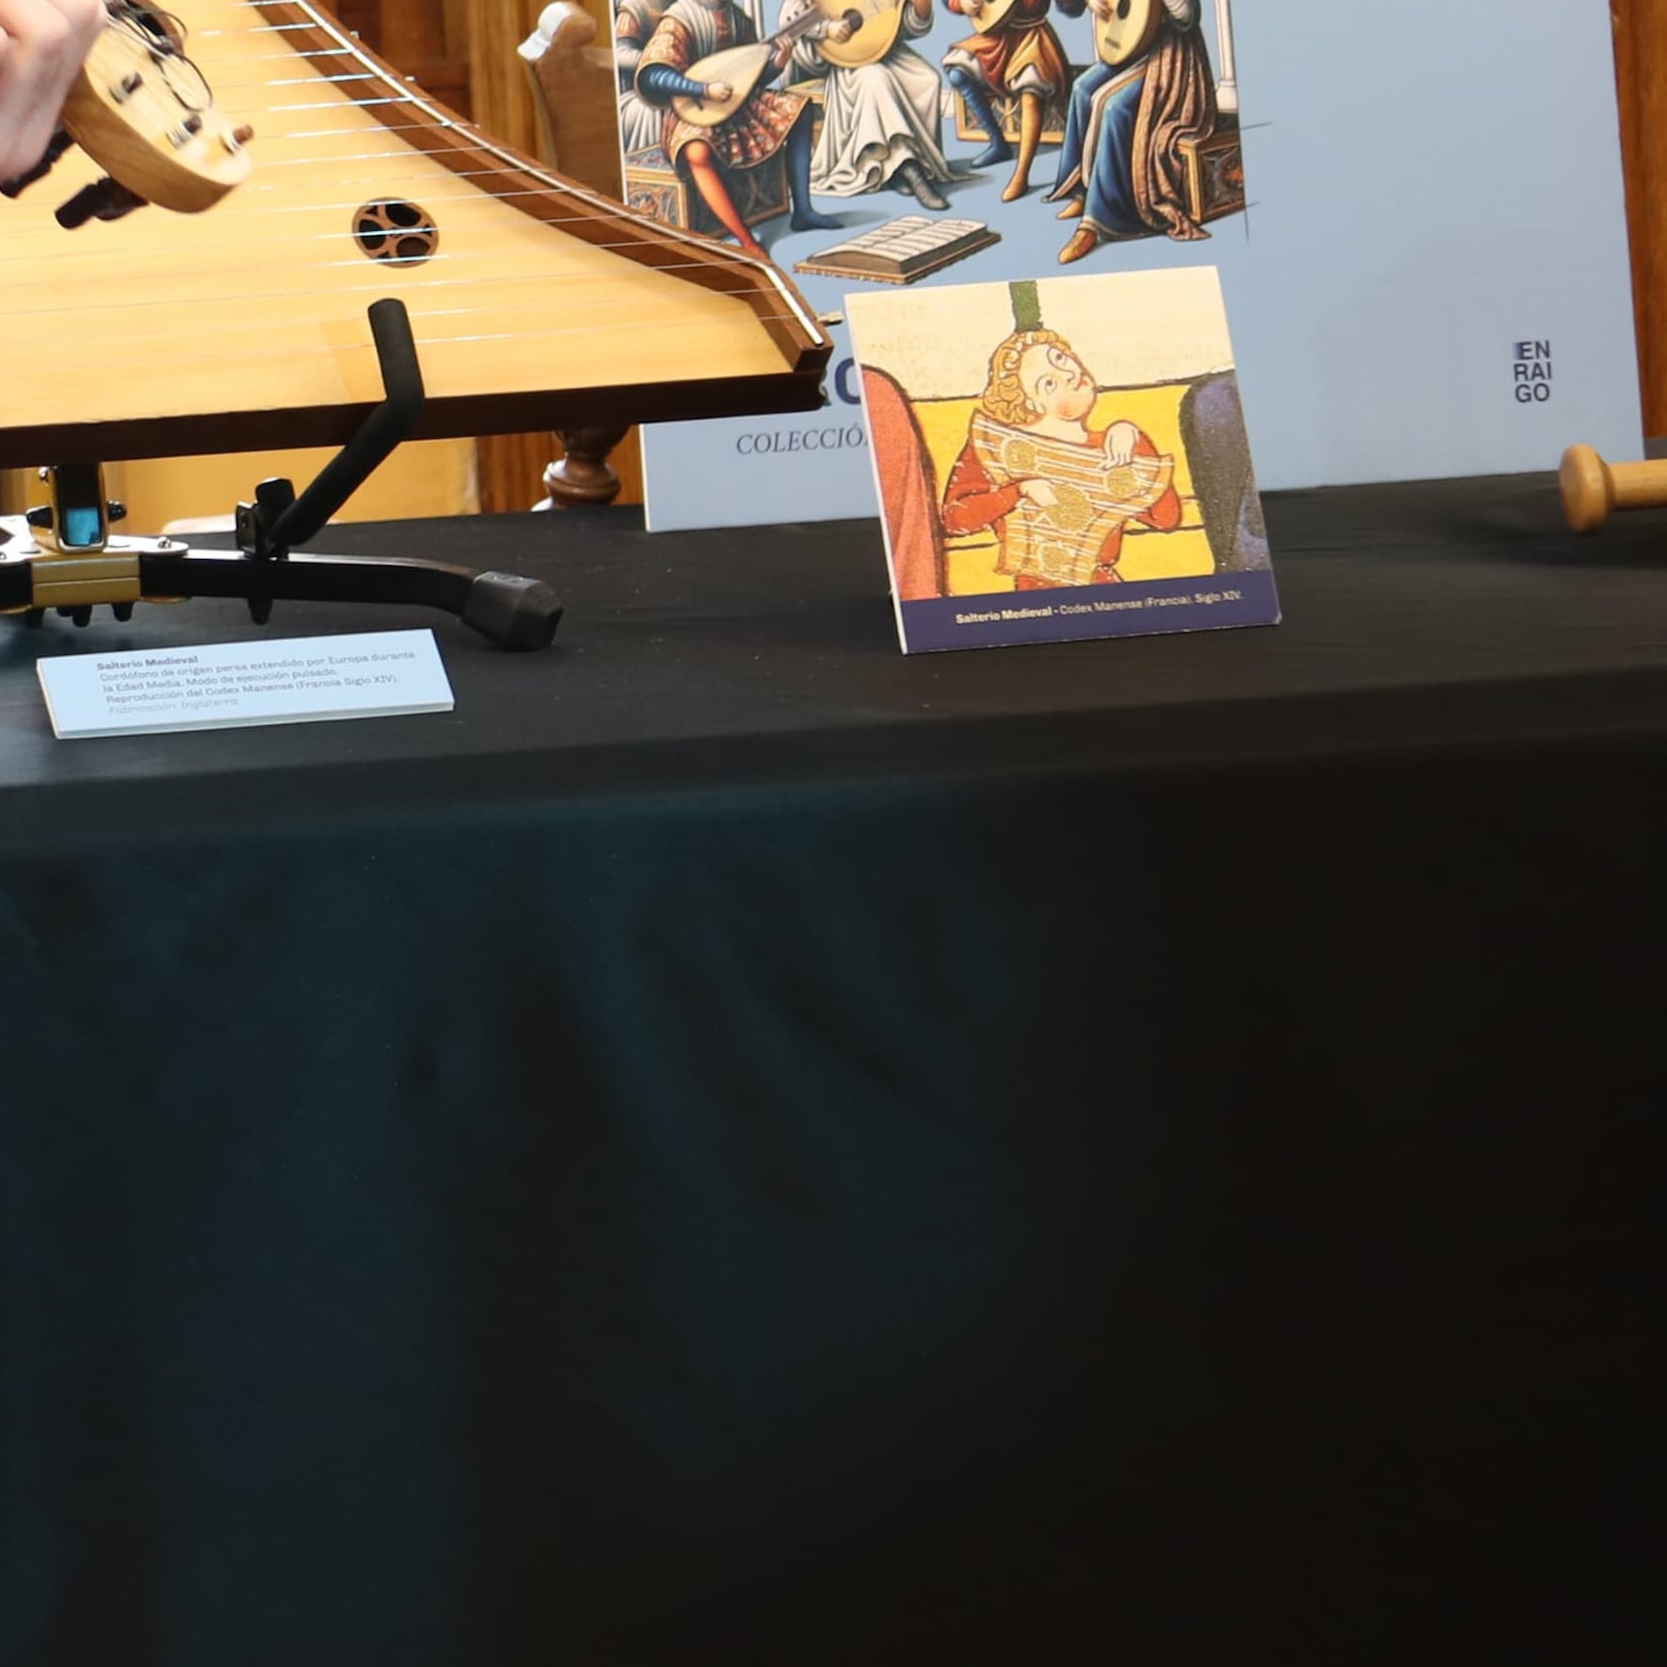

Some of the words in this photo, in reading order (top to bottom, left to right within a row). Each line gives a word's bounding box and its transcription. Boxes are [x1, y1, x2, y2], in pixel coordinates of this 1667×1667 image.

[1513, 340, 1550, 360] EN
[1513, 361, 1552, 382] RAI
[1514, 382, 1550, 403] GO
[736, 423, 869, 455] COLECCIÓ
[956, 610, 1000, 623] Salterio
[1001, 605, 1052, 619] Medieval
[1060, 602, 1091, 614] Codex
[1195, 591, 1220, 605] Siglo
[97, 659, 142, 670] Salterio
[145, 654, 198, 666] Medieval
[99, 669, 158, 681] Cordófono
[161, 668, 174, 676] de
[177, 665, 213, 677] origen
[215, 664, 247, 674] persa
[250, 658, 304, 670] extendido
[306, 659, 325, 667] por
[328, 653, 368, 666] Europa
[371, 650, 419, 661] durante
[102, 684, 113, 692] la
[115, 681, 143, 691] Edad
[185, 676, 217, 686] Modo
[220, 675, 233, 683] de
[236, 670, 289, 684] ejecución
[106, 690, 183, 705] Reproducción
[186, 688, 203, 697] del
[205, 685, 239, 695] Codex
[343, 675, 371, 687] Siglo
